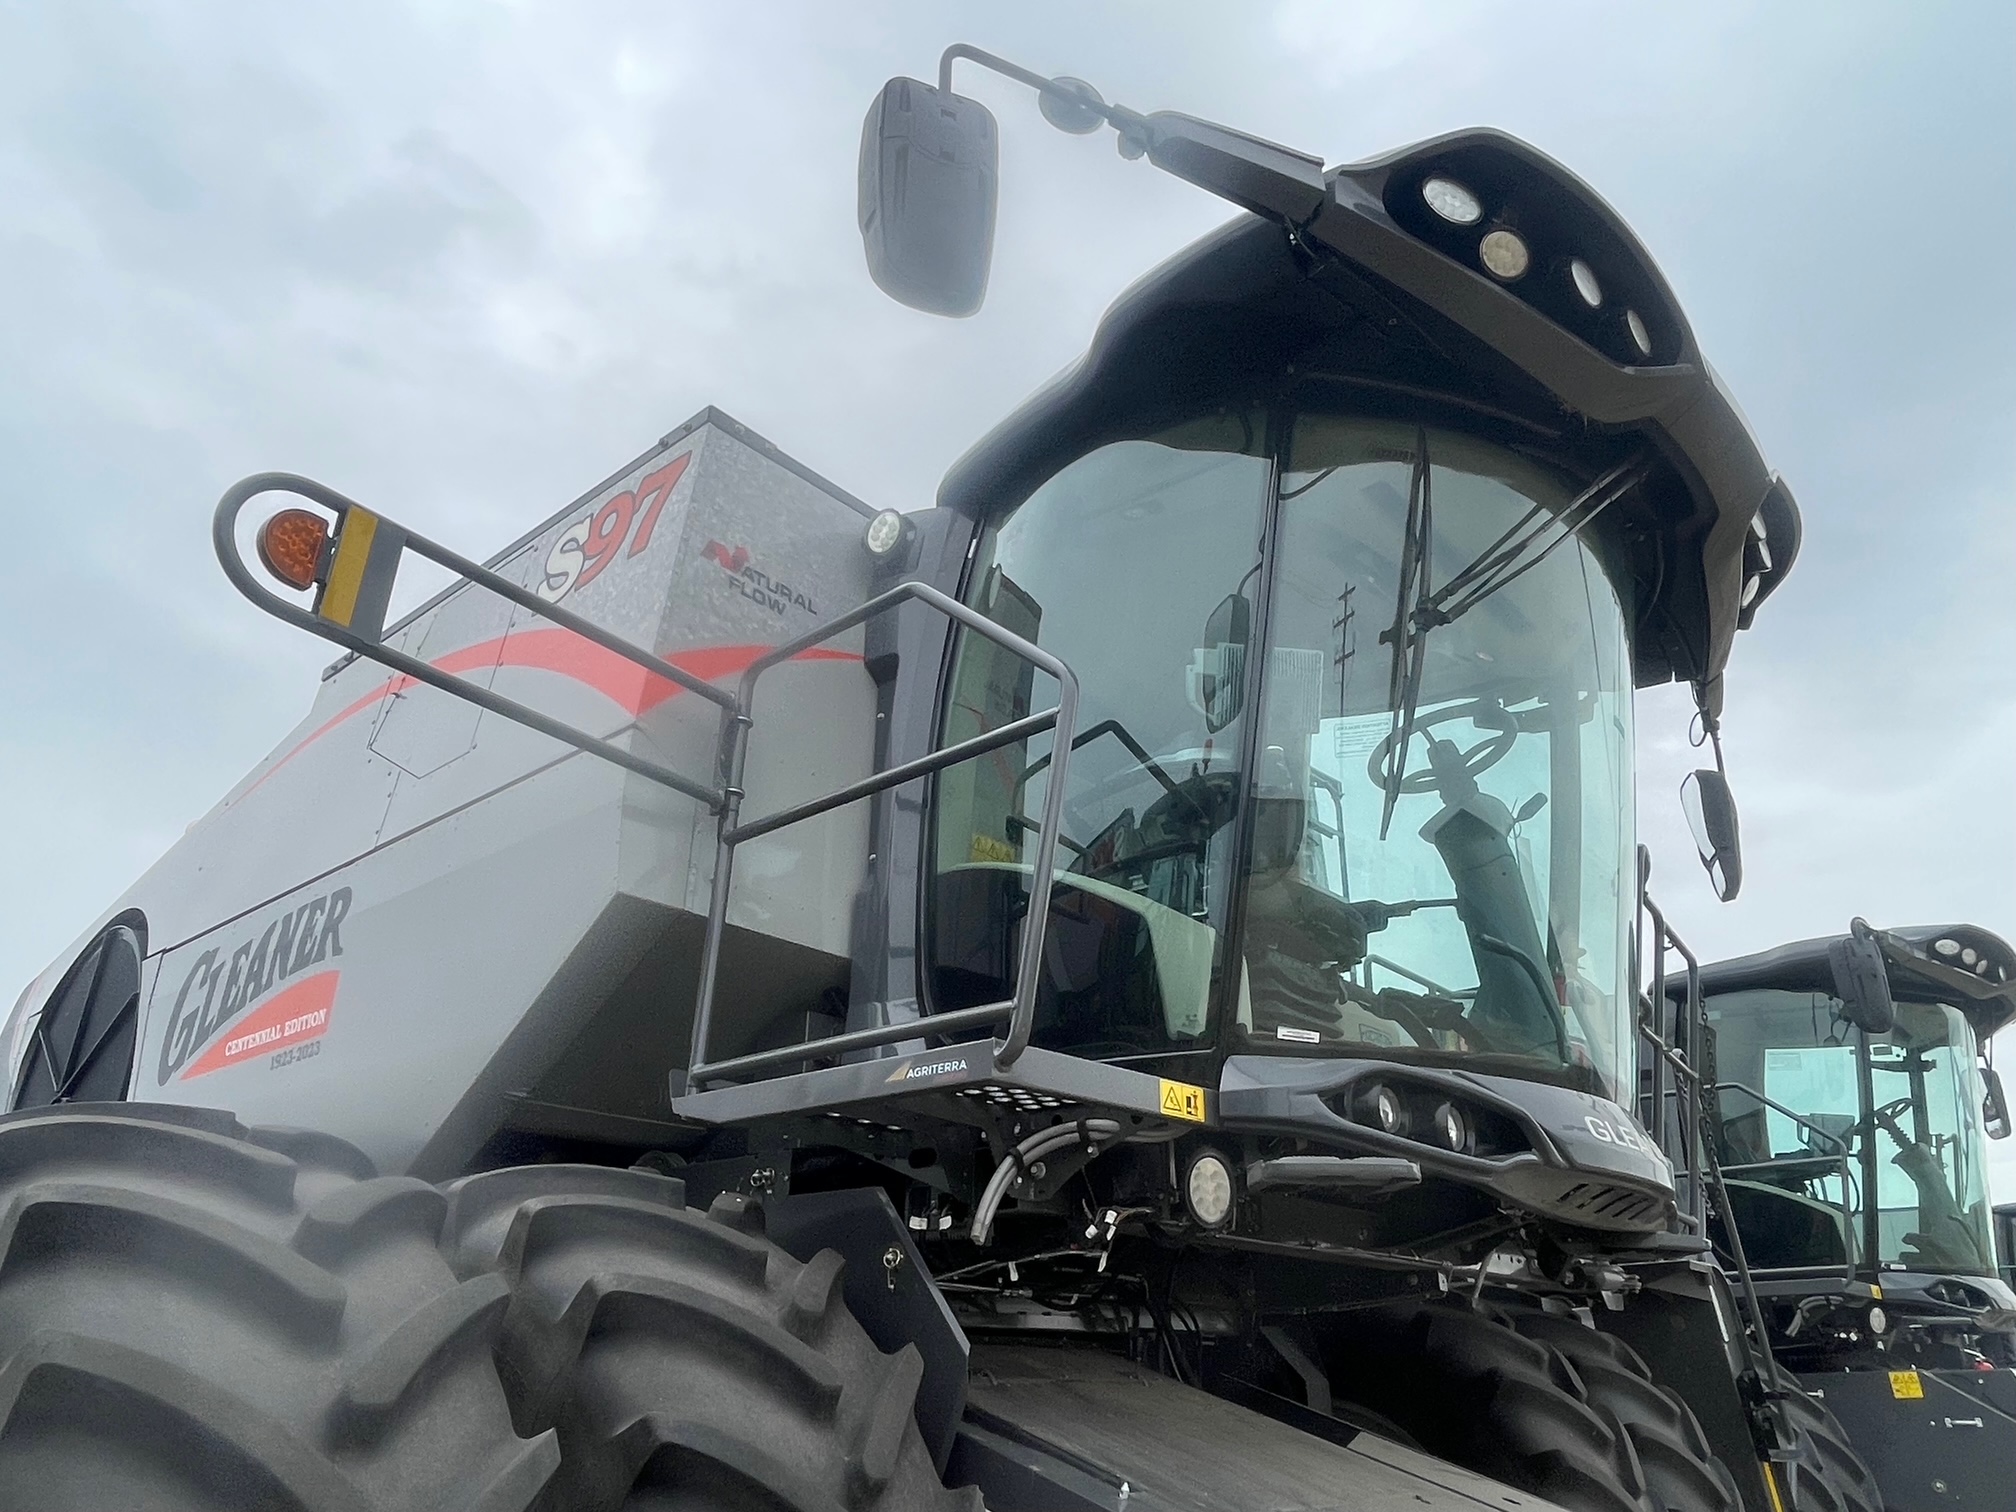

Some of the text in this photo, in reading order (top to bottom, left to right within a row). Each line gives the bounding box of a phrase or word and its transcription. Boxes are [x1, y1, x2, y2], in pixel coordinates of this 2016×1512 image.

[531, 450, 693, 617] S97
[727, 574, 787, 615] FLOW
[158, 887, 353, 1086] GLEANER
[225, 1008, 327, 1057] CENTENNIAL EDITION
[270, 1040, 321, 1071] 1923-2023
[906, 1060, 967, 1079] AGRITERRA
